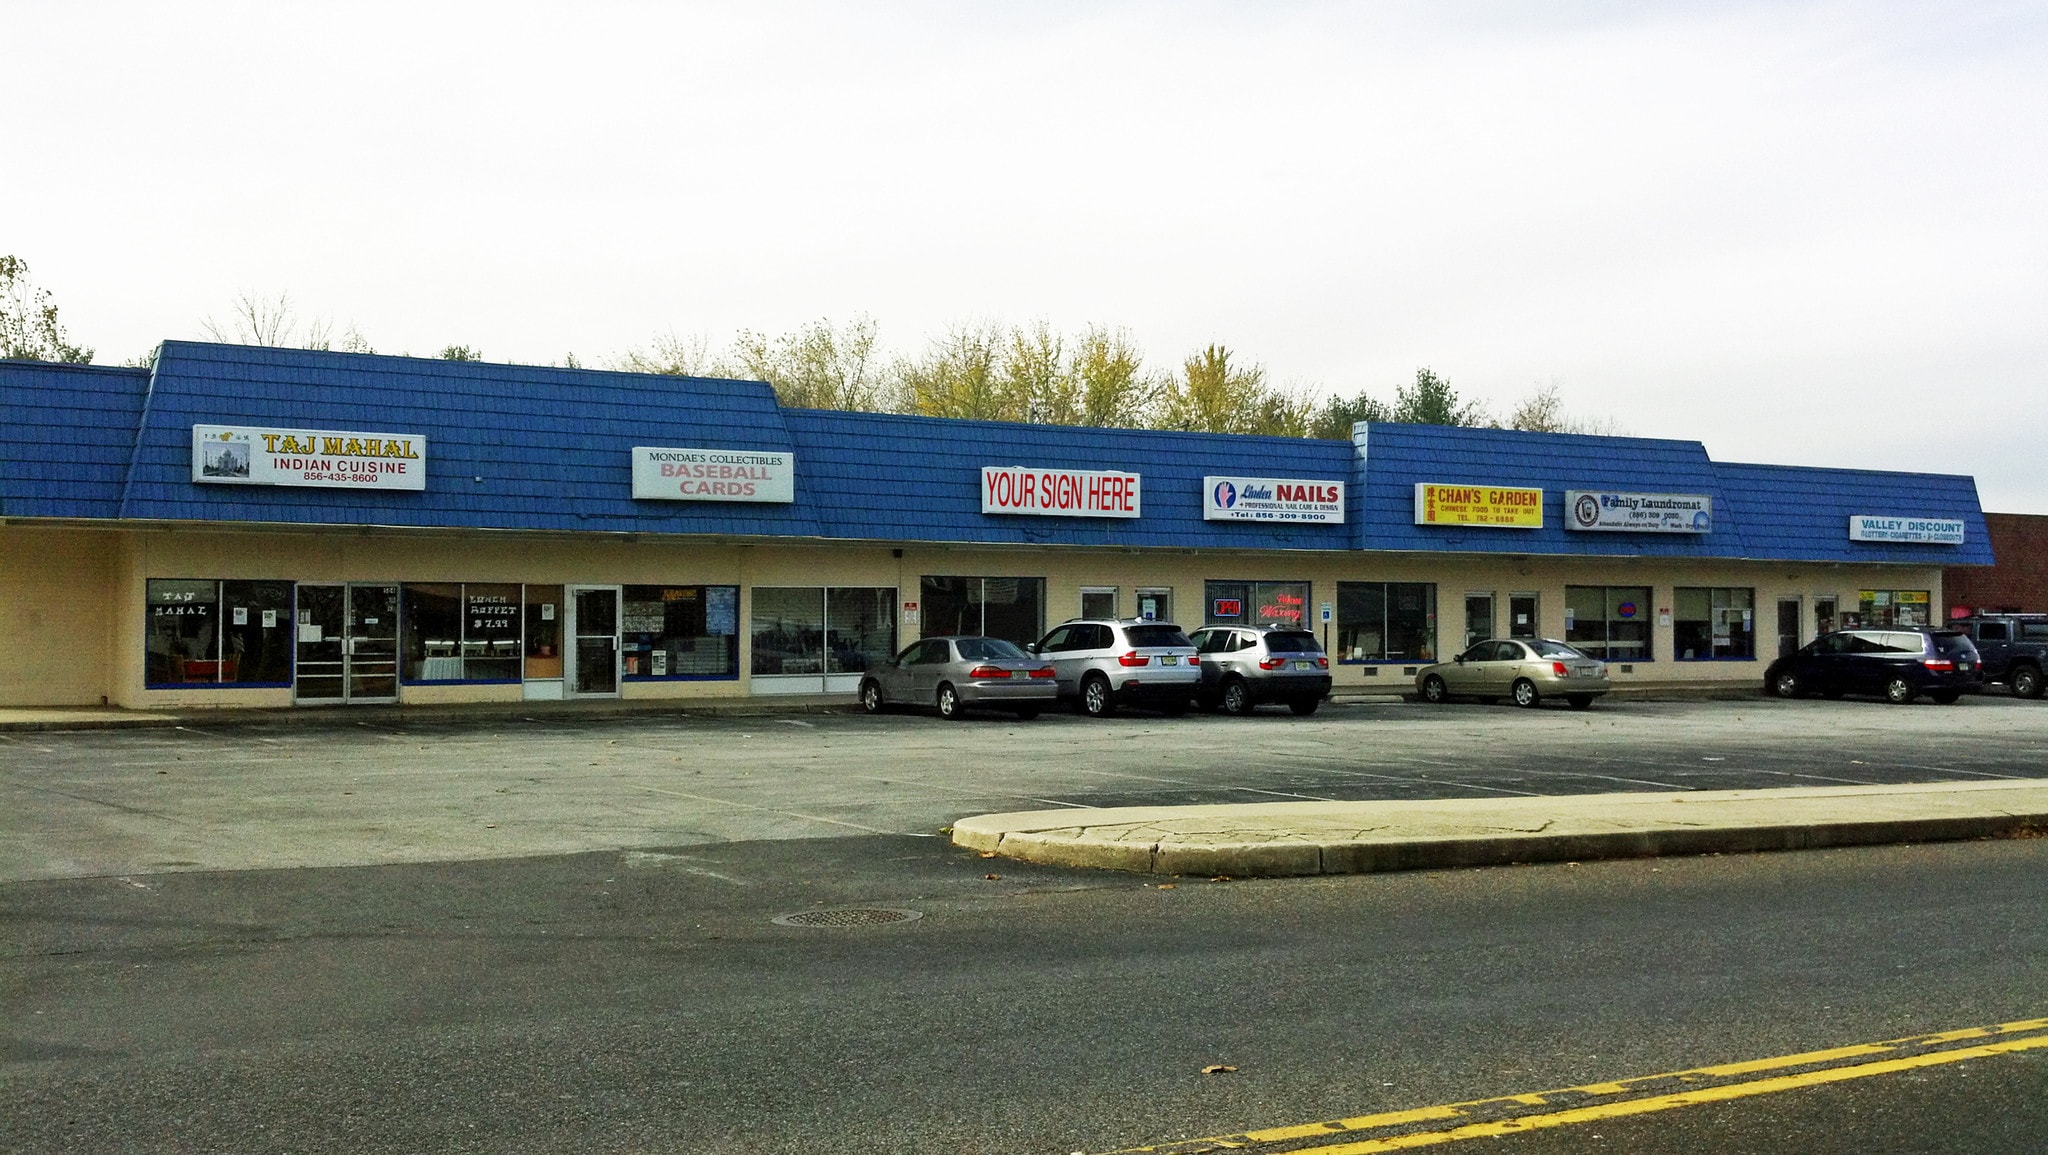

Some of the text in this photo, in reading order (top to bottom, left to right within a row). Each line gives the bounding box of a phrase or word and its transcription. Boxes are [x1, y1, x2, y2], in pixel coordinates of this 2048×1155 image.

[261, 433, 419, 459] TAJ MAHAL
[273, 458, 407, 474] INDIAN CUISINE
[649, 452, 782, 466] MONDAE'S COLLECTIBLES
[303, 472, 378, 483] 856-435-8600
[660, 464, 772, 480] BASEBALL
[679, 480, 756, 496] CARDS
[986, 471, 1135, 511] YOUR SIGN HERE
[1240, 484, 1339, 503] Linden NAILS
[1438, 488, 1537, 506] CHAN'S GARDEN
[1602, 496, 1641, 511] Family
[1641, 498, 1702, 510] Laundromat
[1244, 502, 1284, 510] PROFESSIONAL
[1298, 503, 1313, 511] CARE
[1440, 505, 1467, 513] CHINESE
[1503, 507, 1519, 515] TAKE
[1522, 508, 1535, 516] OUT
[1861, 519, 1962, 533] VALLEY DISCOUNT
[162, 591, 196, 602] TAJ
[469, 595, 507, 604] LUNCH
[1260, 605, 1301, 622] Waxing
[484, 619, 509, 628] 7.99
